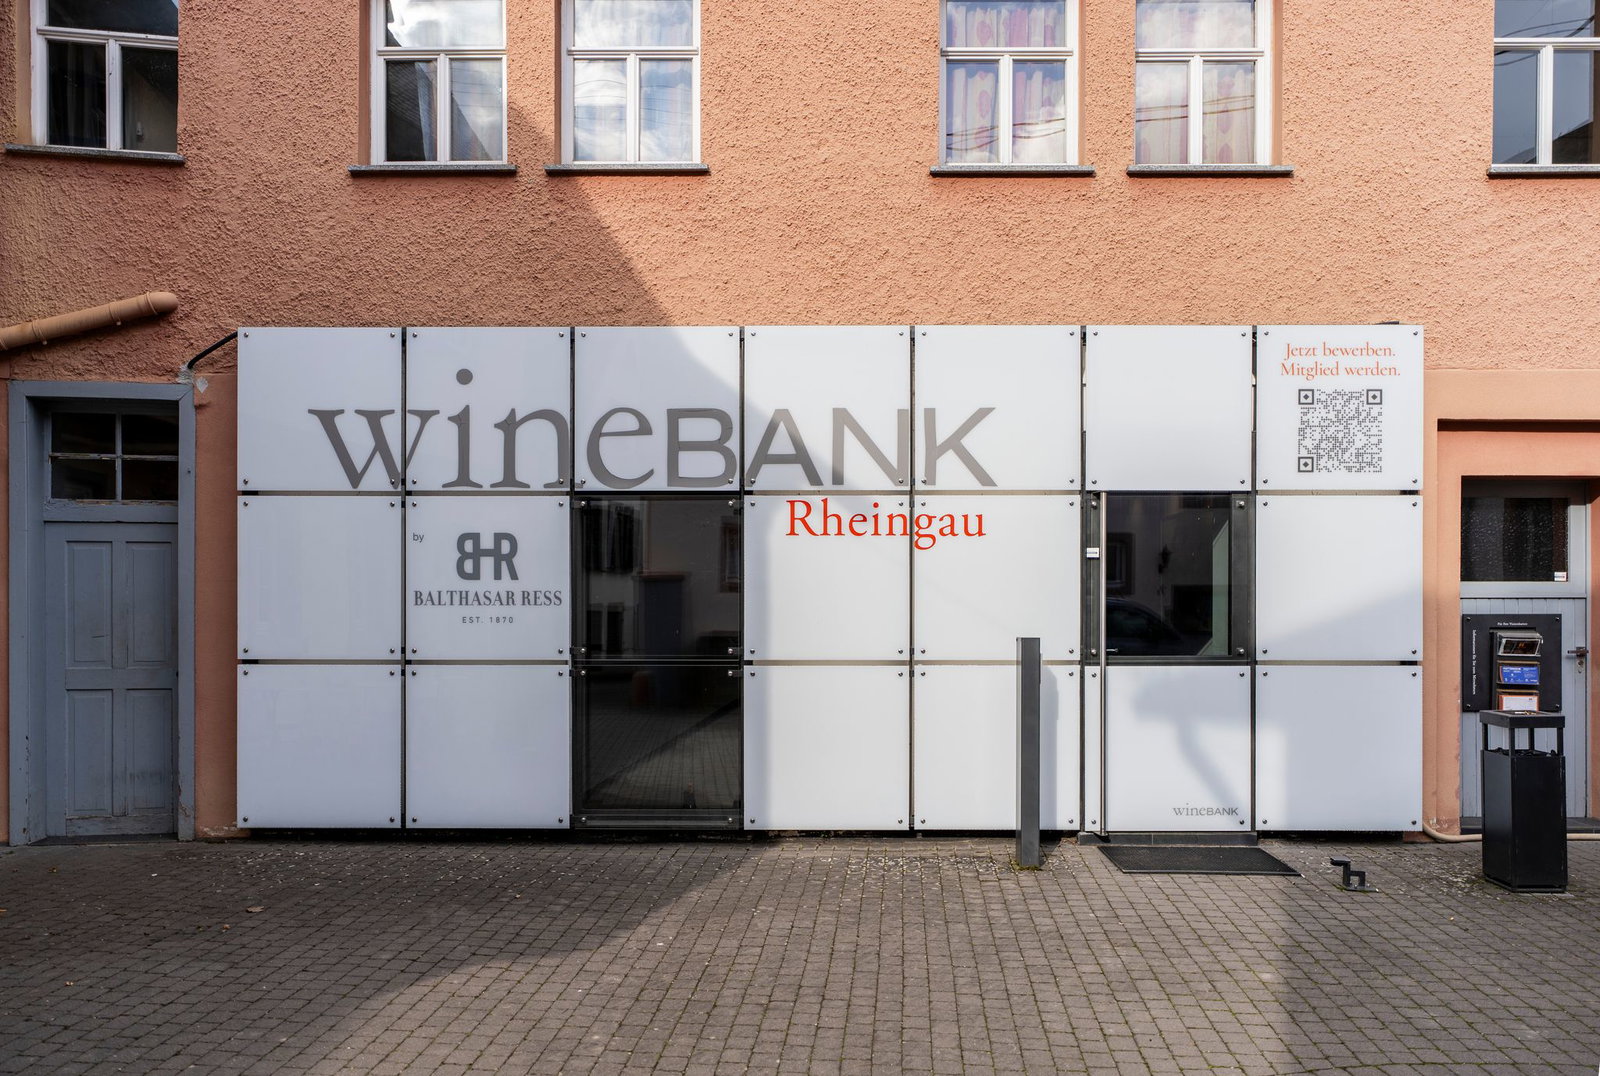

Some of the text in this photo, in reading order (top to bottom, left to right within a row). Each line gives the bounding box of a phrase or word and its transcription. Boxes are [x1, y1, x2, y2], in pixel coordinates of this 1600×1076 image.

[1284, 342, 1396, 360] Jetzt bewerben.
[1280, 361, 1401, 381] Mitglied werden.
[308, 368, 997, 490] wineBANK
[786, 499, 986, 550] Rheingau
[412, 532, 425, 543] by
[414, 590, 563, 606] BALTHASAR RESS
[462, 616, 514, 624] EST. 1870
[1173, 802, 1239, 816] wineBANK
